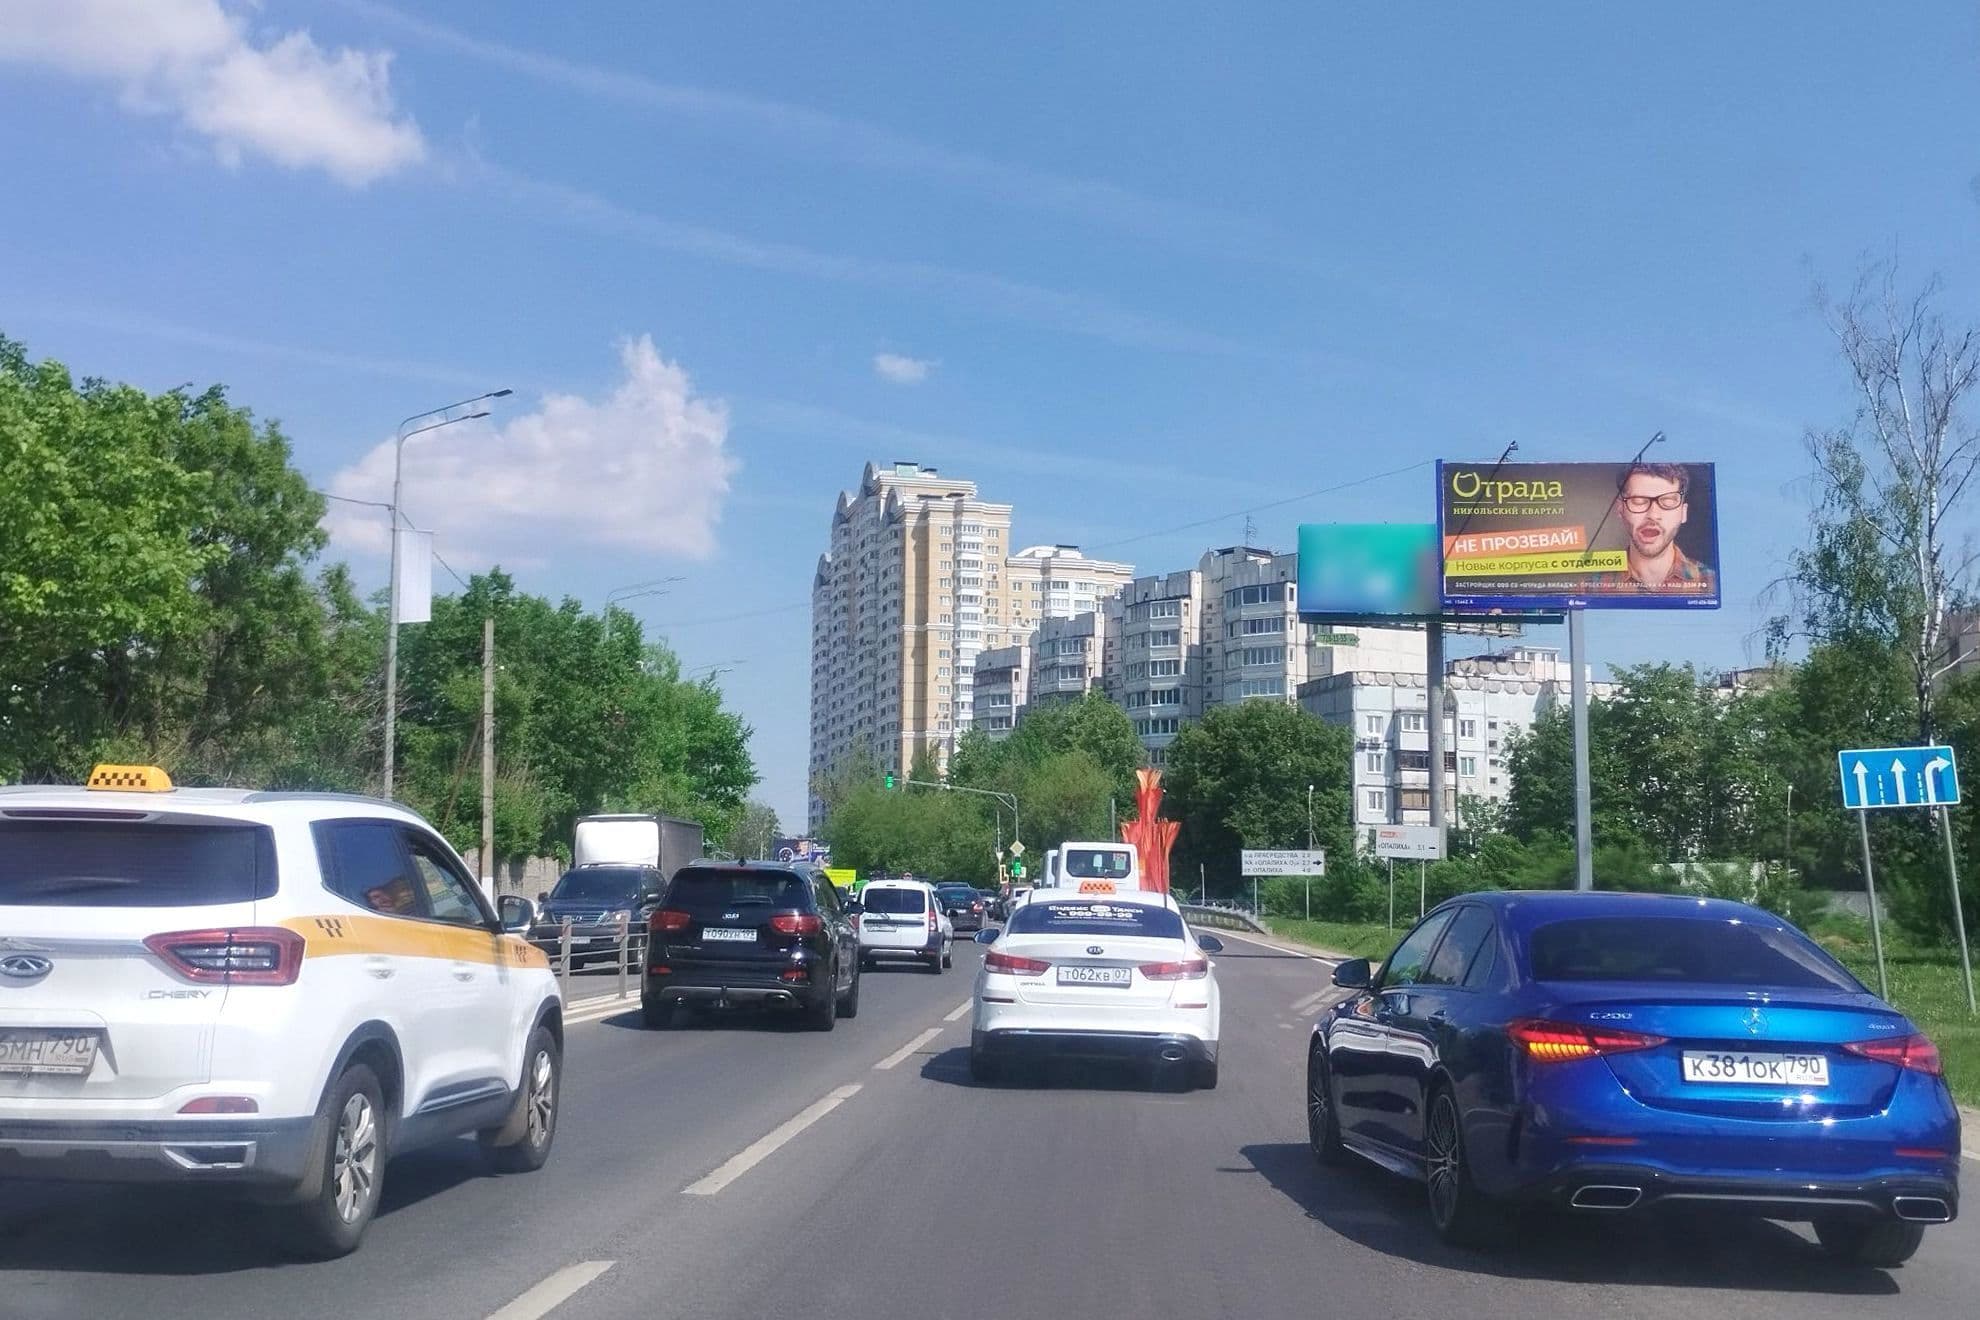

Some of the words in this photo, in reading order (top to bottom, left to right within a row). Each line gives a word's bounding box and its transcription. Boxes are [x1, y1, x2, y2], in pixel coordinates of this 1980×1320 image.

[1453, 471, 1564, 504] Отрада
[1453, 507, 1519, 515] НИКОЛЬСКИЙ
[1521, 507, 1565, 515] КВАРТАЛ
[1455, 539, 1478, 553] НЕ
[1481, 529, 1578, 552] ПРОЗЕВАЙ!
[1455, 560, 1496, 572] Новые
[1498, 559, 1549, 573] корпуса
[1561, 555, 1622, 569] отделкой
[1064, 967, 1110, 982] Т062КВ
[1114, 969, 1126, 979] 07
[148, 990, 212, 999] CHERY
[50, 1034, 87, 1054] 790
[1692, 1054, 1782, 1079] К381ОК
[1785, 1055, 1821, 1074] 790
